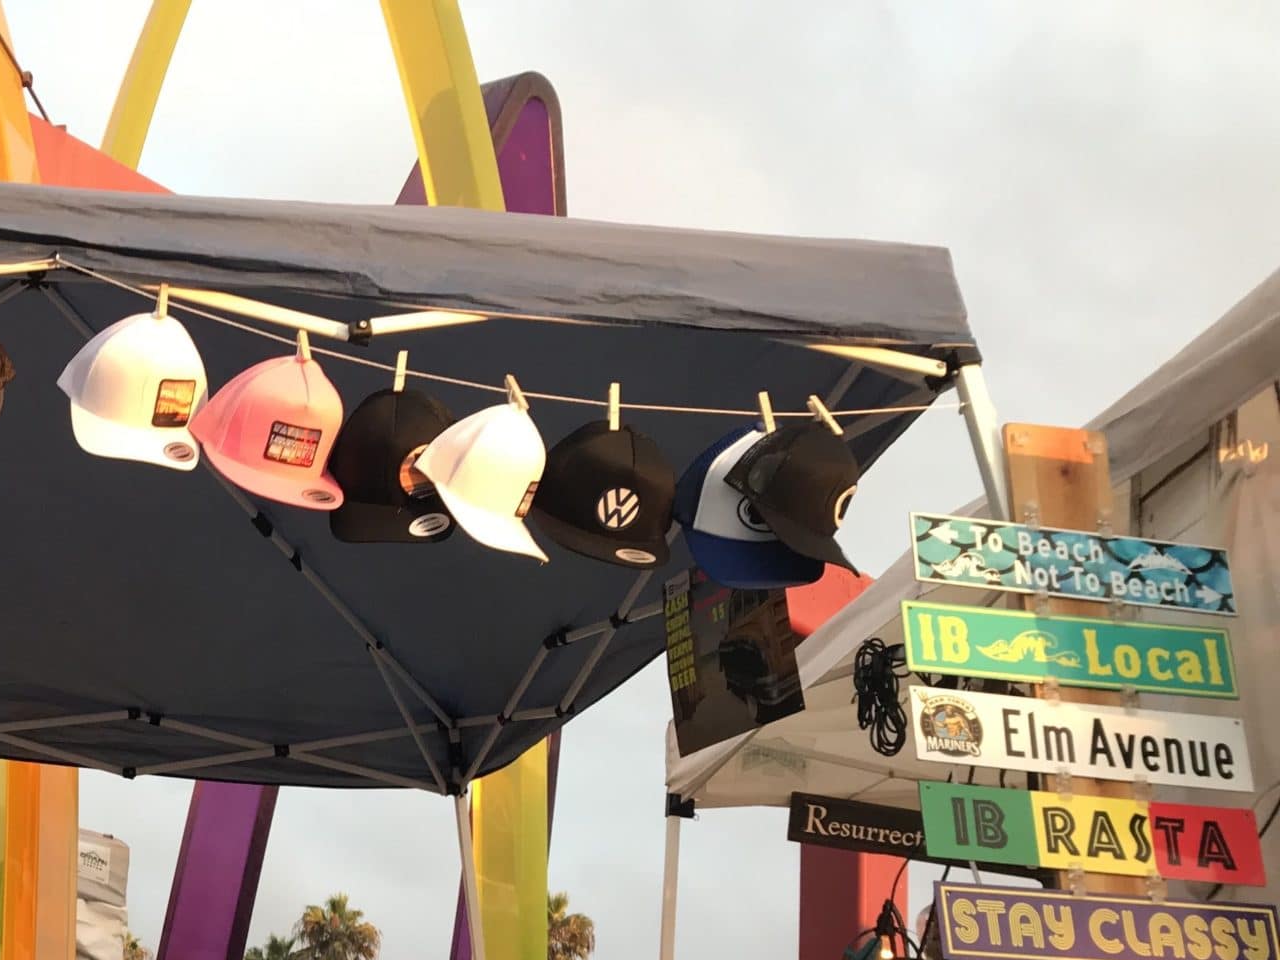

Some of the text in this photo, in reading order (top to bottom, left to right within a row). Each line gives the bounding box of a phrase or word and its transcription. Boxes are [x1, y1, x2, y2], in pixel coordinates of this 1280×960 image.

[969, 526, 1104, 564] To Beach
[1014, 559, 1190, 603] Not To Beach
[917, 613, 1225, 686] IB Local
[1002, 708, 1235, 781] Elm Avenue
[951, 797, 1238, 871] IB RASTA
[951, 898, 1075, 950] STAY
